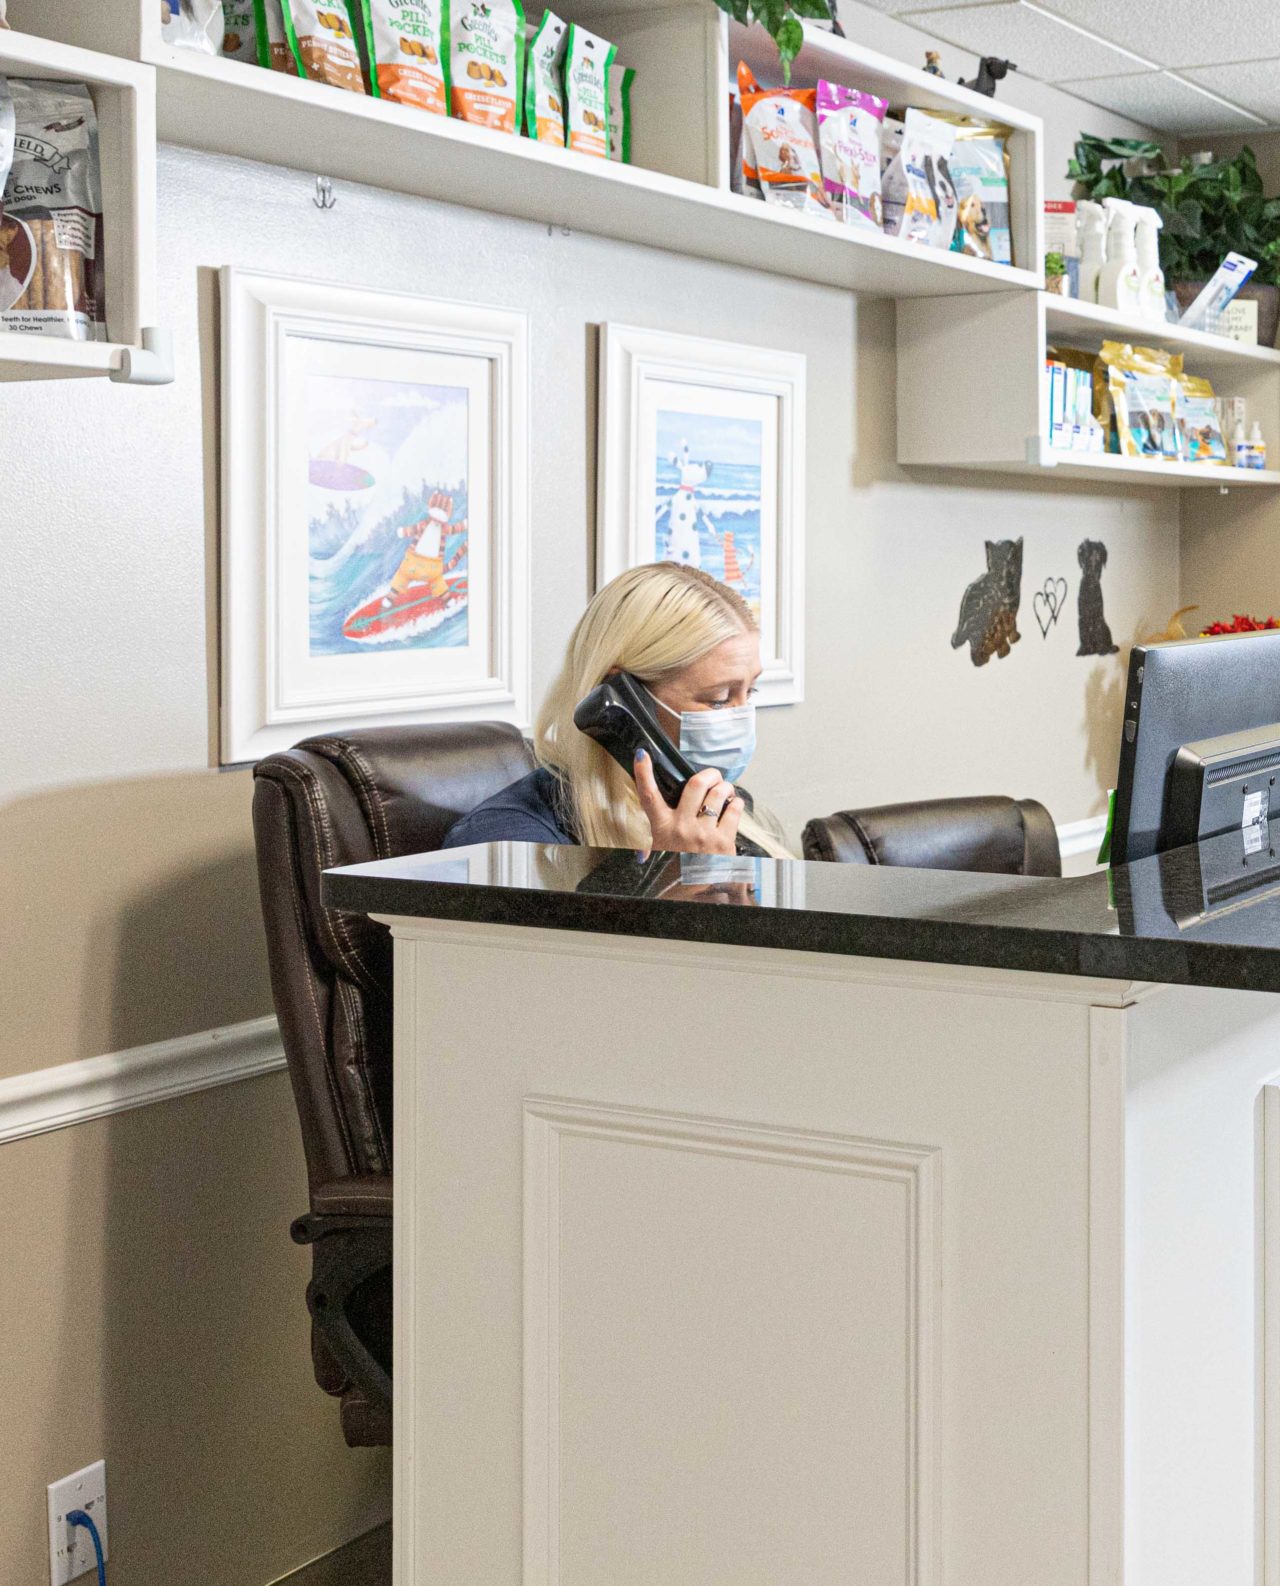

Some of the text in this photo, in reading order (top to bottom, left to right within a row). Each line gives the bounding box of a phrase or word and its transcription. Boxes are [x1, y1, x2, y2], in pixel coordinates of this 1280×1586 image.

[401, 9, 429, 25] PILL
[473, 33, 494, 51] PILL
[457, 42, 507, 65] POCKETS
[14, 183, 61, 195] CHEWS
[22, 314, 31, 322] for
